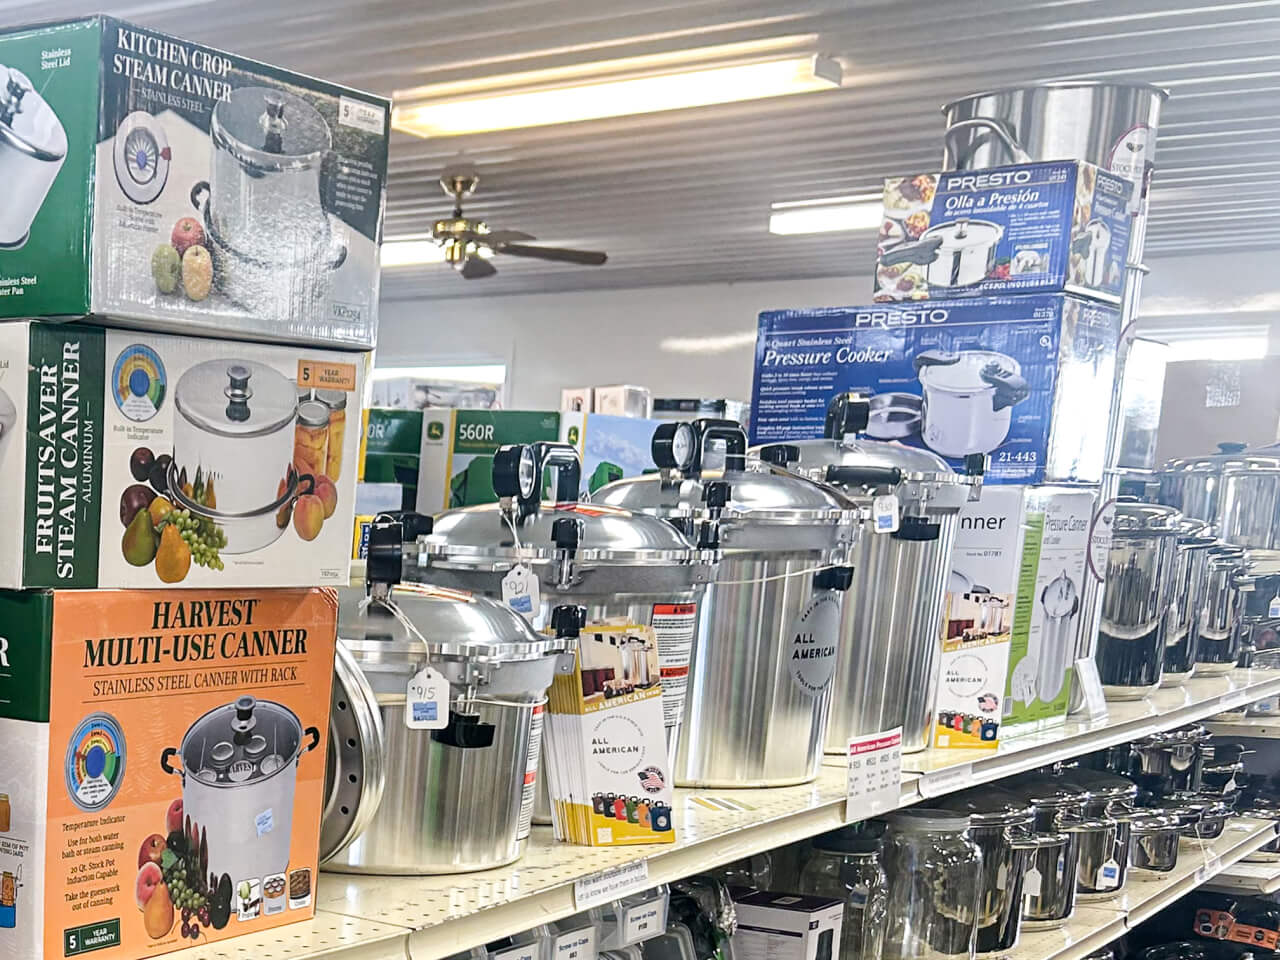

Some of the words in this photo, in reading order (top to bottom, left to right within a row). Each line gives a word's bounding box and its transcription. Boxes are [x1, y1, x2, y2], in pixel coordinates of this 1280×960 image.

[118, 28, 189, 65] KITCHEN
[192, 51, 231, 76] CROP
[113, 54, 168, 86] STEAM
[171, 69, 231, 102] CANNER
[142, 90, 179, 107] STAINLESS
[182, 99, 203, 113] STEEL
[947, 171, 1030, 191] PRESTO
[946, 197, 973, 209] Olla
[977, 197, 985, 206] a
[989, 189, 1039, 206] Presión
[21, 276, 36, 286] Steel
[856, 310, 948, 329] PRESTO
[771, 339, 796, 348] Quart
[797, 338, 832, 346] Stainless
[763, 350, 831, 366] Pressure
[837, 348, 893, 363] Cooker
[60, 342, 80, 470] CANNER
[459, 424, 495, 441] 560R
[35, 364, 58, 554] FRUITSAVER
[83, 420, 94, 503] ALUMINUM
[999, 453, 1037, 462] 21-443
[57, 476, 75, 579] STEAM
[961, 516, 1006, 529] nner
[152, 600, 255, 629] HARVEST
[794, 633, 815, 644] ALL
[83, 634, 215, 668] MULTI-USE
[220, 629, 307, 658] CANNER
[792, 646, 835, 660] AMERICAN
[93, 678, 154, 696] STAINLESS
[158, 675, 190, 691] STEEL
[194, 672, 237, 688] CANNER
[241, 669, 266, 685] WITH
[269, 667, 297, 682] RACK
[593, 746, 638, 754] AMERICAN
[62, 819, 98, 832] Temperature
[100, 815, 125, 825] Indicator
[68, 838, 78, 847] Use
[79, 837, 87, 845] for
[89, 835, 101, 844] both
[102, 832, 119, 842] water
[78, 863, 87, 872] Qt.
[89, 860, 104, 870] Stock
[105, 858, 115, 867] Pot
[85, 933, 115, 947] WARRANTY
